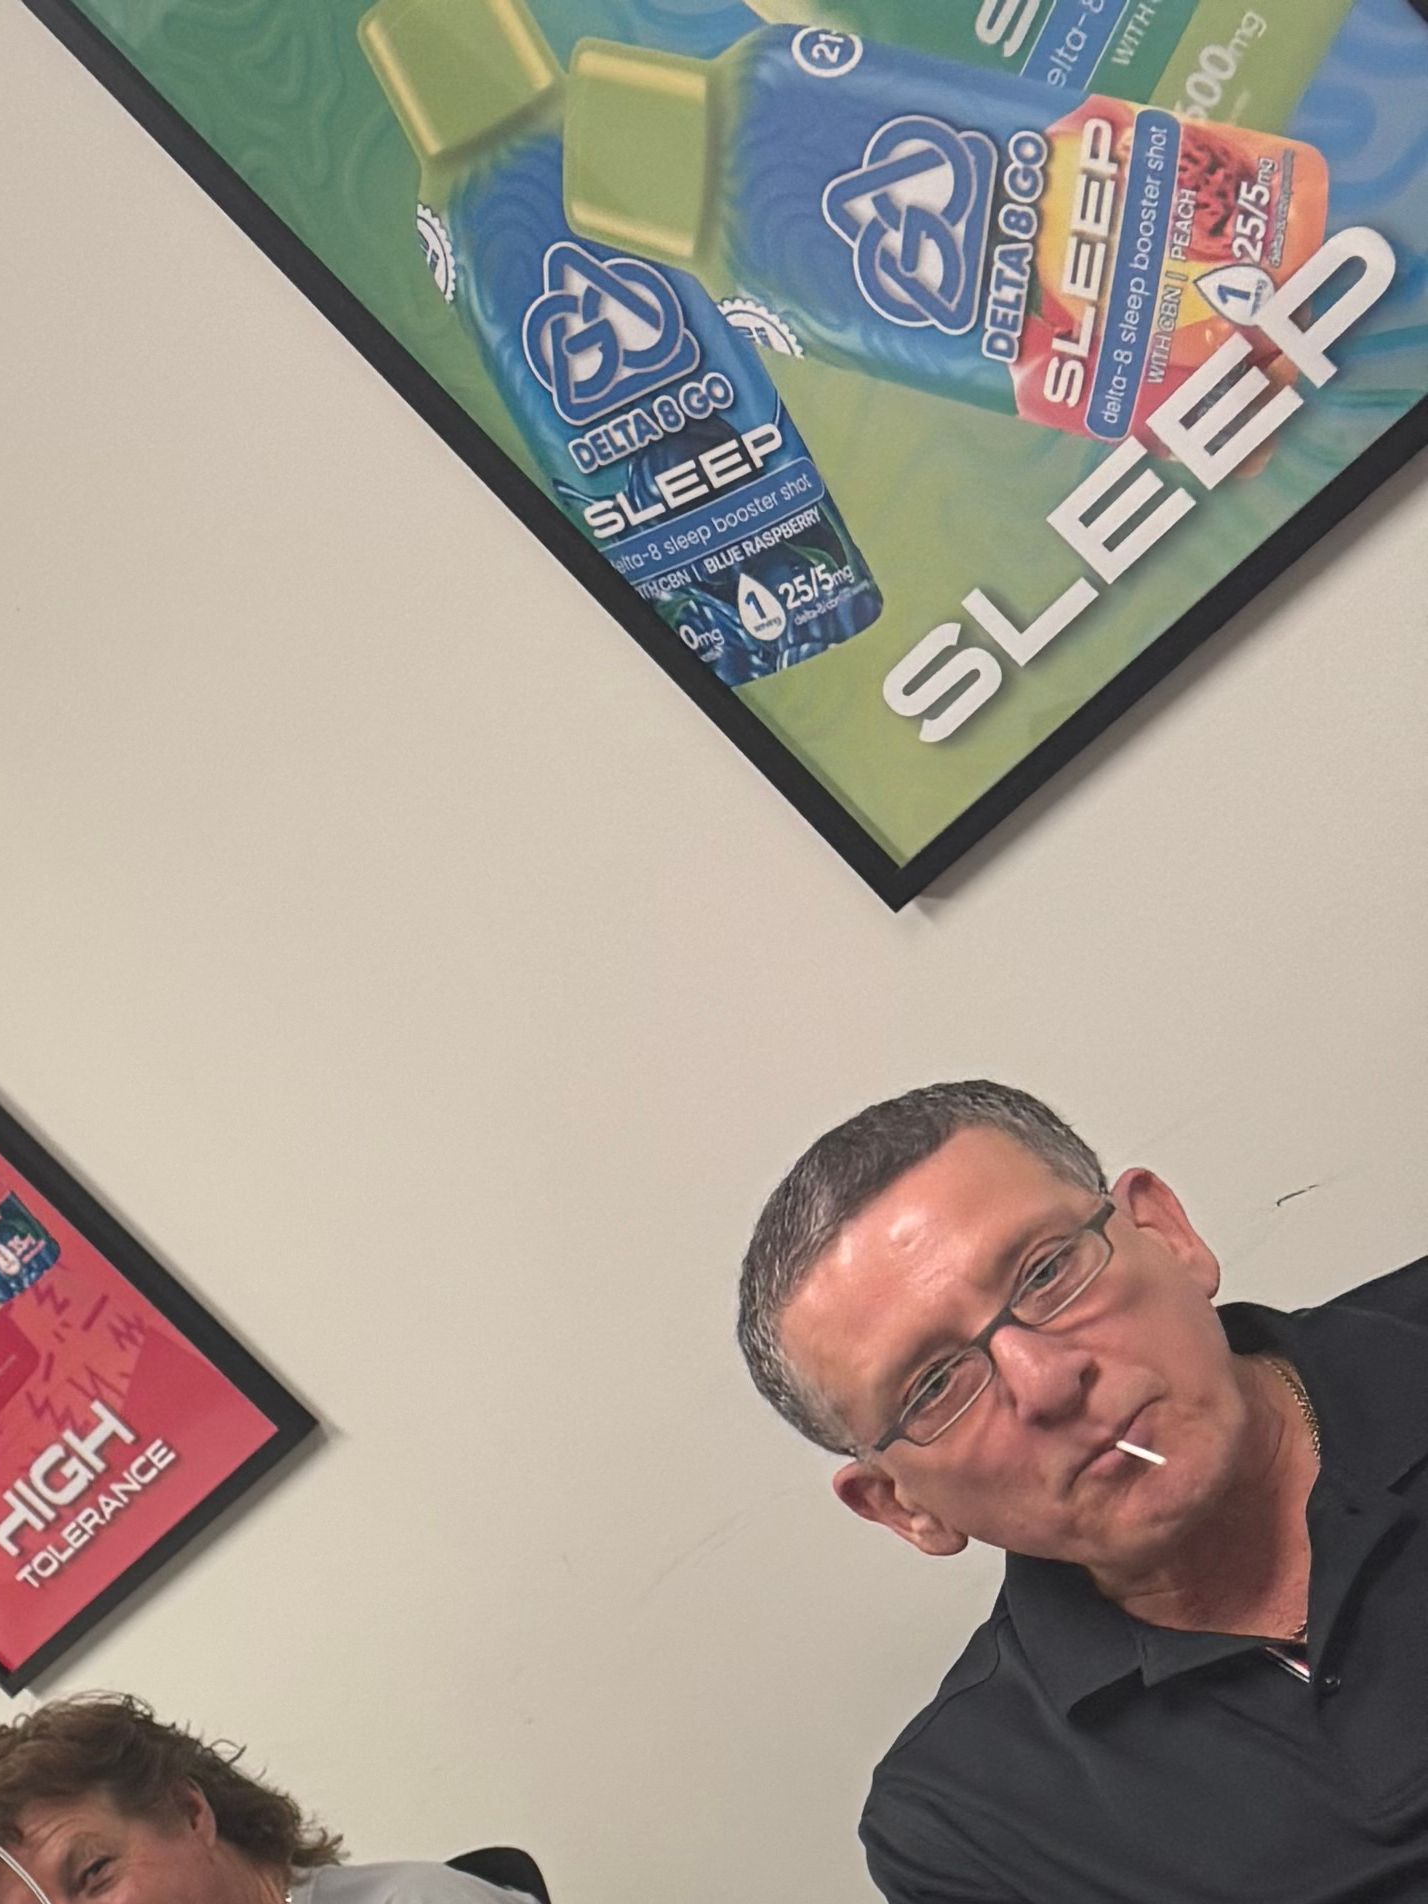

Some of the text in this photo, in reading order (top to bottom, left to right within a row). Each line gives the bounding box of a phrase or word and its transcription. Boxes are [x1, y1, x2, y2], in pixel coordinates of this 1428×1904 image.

[982, 131, 1048, 363] DELTA 8 GO
[1044, 118, 1120, 408] SLEEP
[1103, 126, 1169, 425] delta-8 sleep booster shot
[1147, 336, 1175, 385] WITH
[1170, 188, 1198, 263] PEACH
[1217, 282, 1253, 309] 1
[568, 372, 734, 474] DELTA 8 GO
[583, 423, 783, 539] SLEEP
[664, 521, 712, 556] sleep
[716, 491, 780, 533] booster
[780, 473, 813, 504] shot
[883, 226, 1397, 744] SLEEP
[659, 567, 692, 593] CBN
[703, 544, 745, 575] BLUE
[741, 506, 823, 558] RASPBERRY
[744, 589, 769, 619] 1
[778, 562, 855, 611] 25/5mg
[15, 1438, 178, 1589] TOLERANCE
